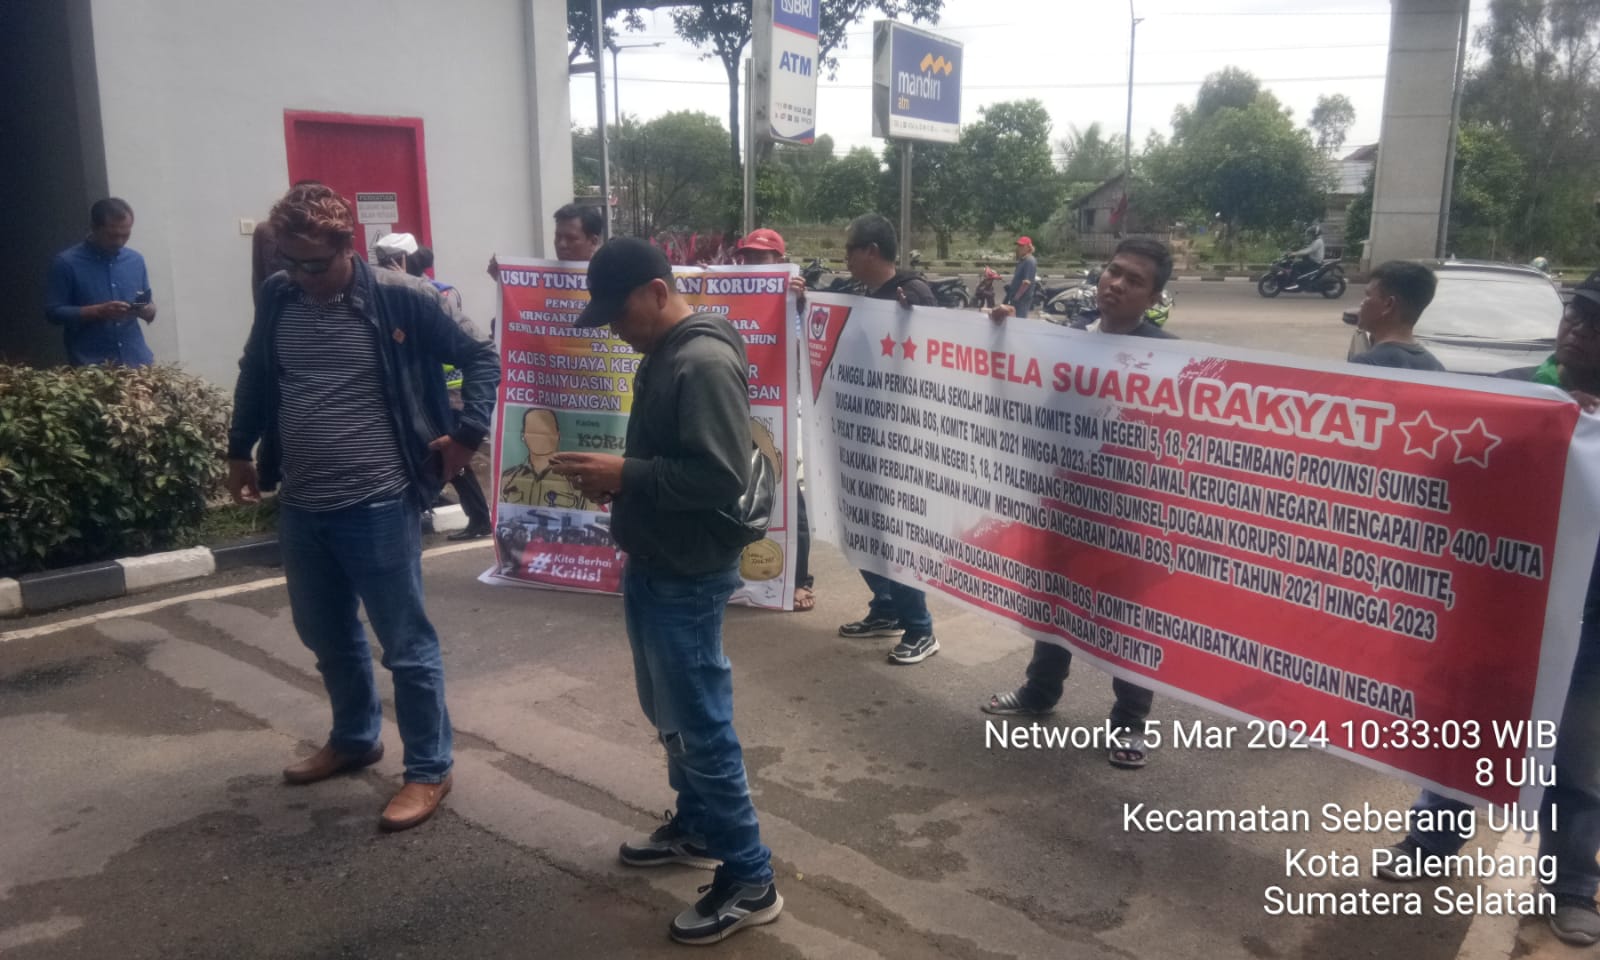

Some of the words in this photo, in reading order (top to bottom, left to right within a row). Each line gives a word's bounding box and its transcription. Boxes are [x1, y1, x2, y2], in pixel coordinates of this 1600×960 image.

[794, 0, 812, 18] BRI
[779, 50, 812, 77] ATM
[898, 70, 941, 101] mandiri
[898, 96, 910, 110] atm
[500, 269, 541, 288] USUT
[542, 273, 588, 289] TUNT
[675, 278, 703, 294] AN
[705, 277, 785, 294] KORUPSI
[545, 298, 587, 310] PENYE
[549, 327, 610, 339] RATUSAN
[744, 334, 777, 345] AHUN
[591, 343, 608, 353] TA
[612, 345, 634, 354] 202
[507, 351, 547, 367] KADES
[549, 355, 607, 371] SRIJAYA
[617, 378, 628, 391] &
[926, 338, 1042, 388] PEMBELA
[1052, 362, 1181, 414] SUARA
[1190, 378, 1394, 449] RAKYAT
[837, 364, 865, 388] PANGGIL
[866, 370, 883, 390] DAN
[884, 374, 918, 396] PERIKSA
[919, 380, 947, 402] KEPALA
[948, 387, 983, 413] SEKOLAH
[984, 395, 1001, 417] DAN
[1002, 398, 1033, 424] KETUA
[1035, 405, 1072, 434] KOMITE
[1074, 415, 1099, 441] SMA
[1101, 420, 1147, 450] NEGERI
[1149, 428, 1161, 457] 5,
[1164, 431, 1184, 463] 18,
[1187, 435, 1202, 461] 21
[1206, 438, 1295, 477] PALEMBANG
[1298, 454, 1376, 496] PROVINSI
[1377, 469, 1450, 511] SUMSEL
[835, 392, 863, 415] DUGAAN
[864, 398, 899, 422] KORUPSI
[901, 404, 921, 428] DANA
[922, 413, 939, 436] BOS,
[940, 415, 969, 441] KOMITE
[970, 423, 998, 449] TAHUN
[999, 430, 1020, 454] 2021
[1021, 436, 1059, 466] HINGGA
[1089, 453, 1147, 487] ESTIMASI
[1149, 464, 1186, 495] AWAL
[1188, 473, 1263, 514] KERUGIAN
[1264, 490, 1328, 529] NEGARA
[1331, 504, 1420, 550] MENCAPAI
[1422, 524, 1449, 555] RP
[1451, 530, 1489, 564] 400
[1490, 538, 1543, 578] JUTA
[856, 424, 886, 448] KEPALA
[887, 431, 924, 456] SEKOLAH
[924, 442, 940, 462] SMA
[940, 446, 968, 470] NEGERI
[969, 456, 978, 477] 5,
[979, 457, 992, 482] 18,
[993, 462, 1003, 483] 21
[1004, 465, 1061, 499] PALEMBANG
[1062, 479, 1113, 514] PROVINSI
[1227, 519, 1293, 560] KORUPSI
[1294, 537, 1338, 573] DANA
[858, 480, 896, 507] KANTONG
[897, 491, 928, 518] PRIBADI
[554, 554, 576, 565] Kita
[879, 457, 924, 486] PERBUATAN
[924, 471, 961, 500] MELAWAN
[961, 484, 992, 510] HUKUM
[994, 494, 1048, 529] MEMOTONG
[1049, 509, 1106, 548] ANGGARAN
[1108, 527, 1142, 558] DANA
[1143, 535, 1175, 573] BOS,
[1176, 545, 1230, 582] KOMITE
[1232, 560, 1282, 599] TAHUN
[1285, 575, 1320, 609] 2021
[1324, 586, 1388, 629] HINGGA
[1392, 606, 1436, 641] 2023
[551, 564, 602, 583] Kritis!
[869, 537, 880, 556] RP
[880, 541, 894, 562] 400
[895, 547, 917, 571] JUTA,
[919, 556, 943, 581] SURAT
[944, 565, 981, 596] LAPORAN
[981, 583, 1051, 624] PERTANGGUNG
[1053, 606, 1097, 644] JAWABAN
[1098, 627, 1120, 655] SPJ
[1122, 636, 1164, 671] FIKTIP
[871, 511, 904, 537] SEBAGAI
[905, 522, 964, 560] TERSANGKANYA
[965, 545, 1000, 576] DUGAAN
[1001, 558, 1042, 592] KORUPSI
[1072, 579, 1095, 616] BOS,
[1096, 592, 1142, 628] KOMITE
[1144, 608, 1259, 667] MENGAKIBATKAN
[1262, 646, 1341, 696] KERUGIAN
[1343, 672, 1415, 719] NEGARA
